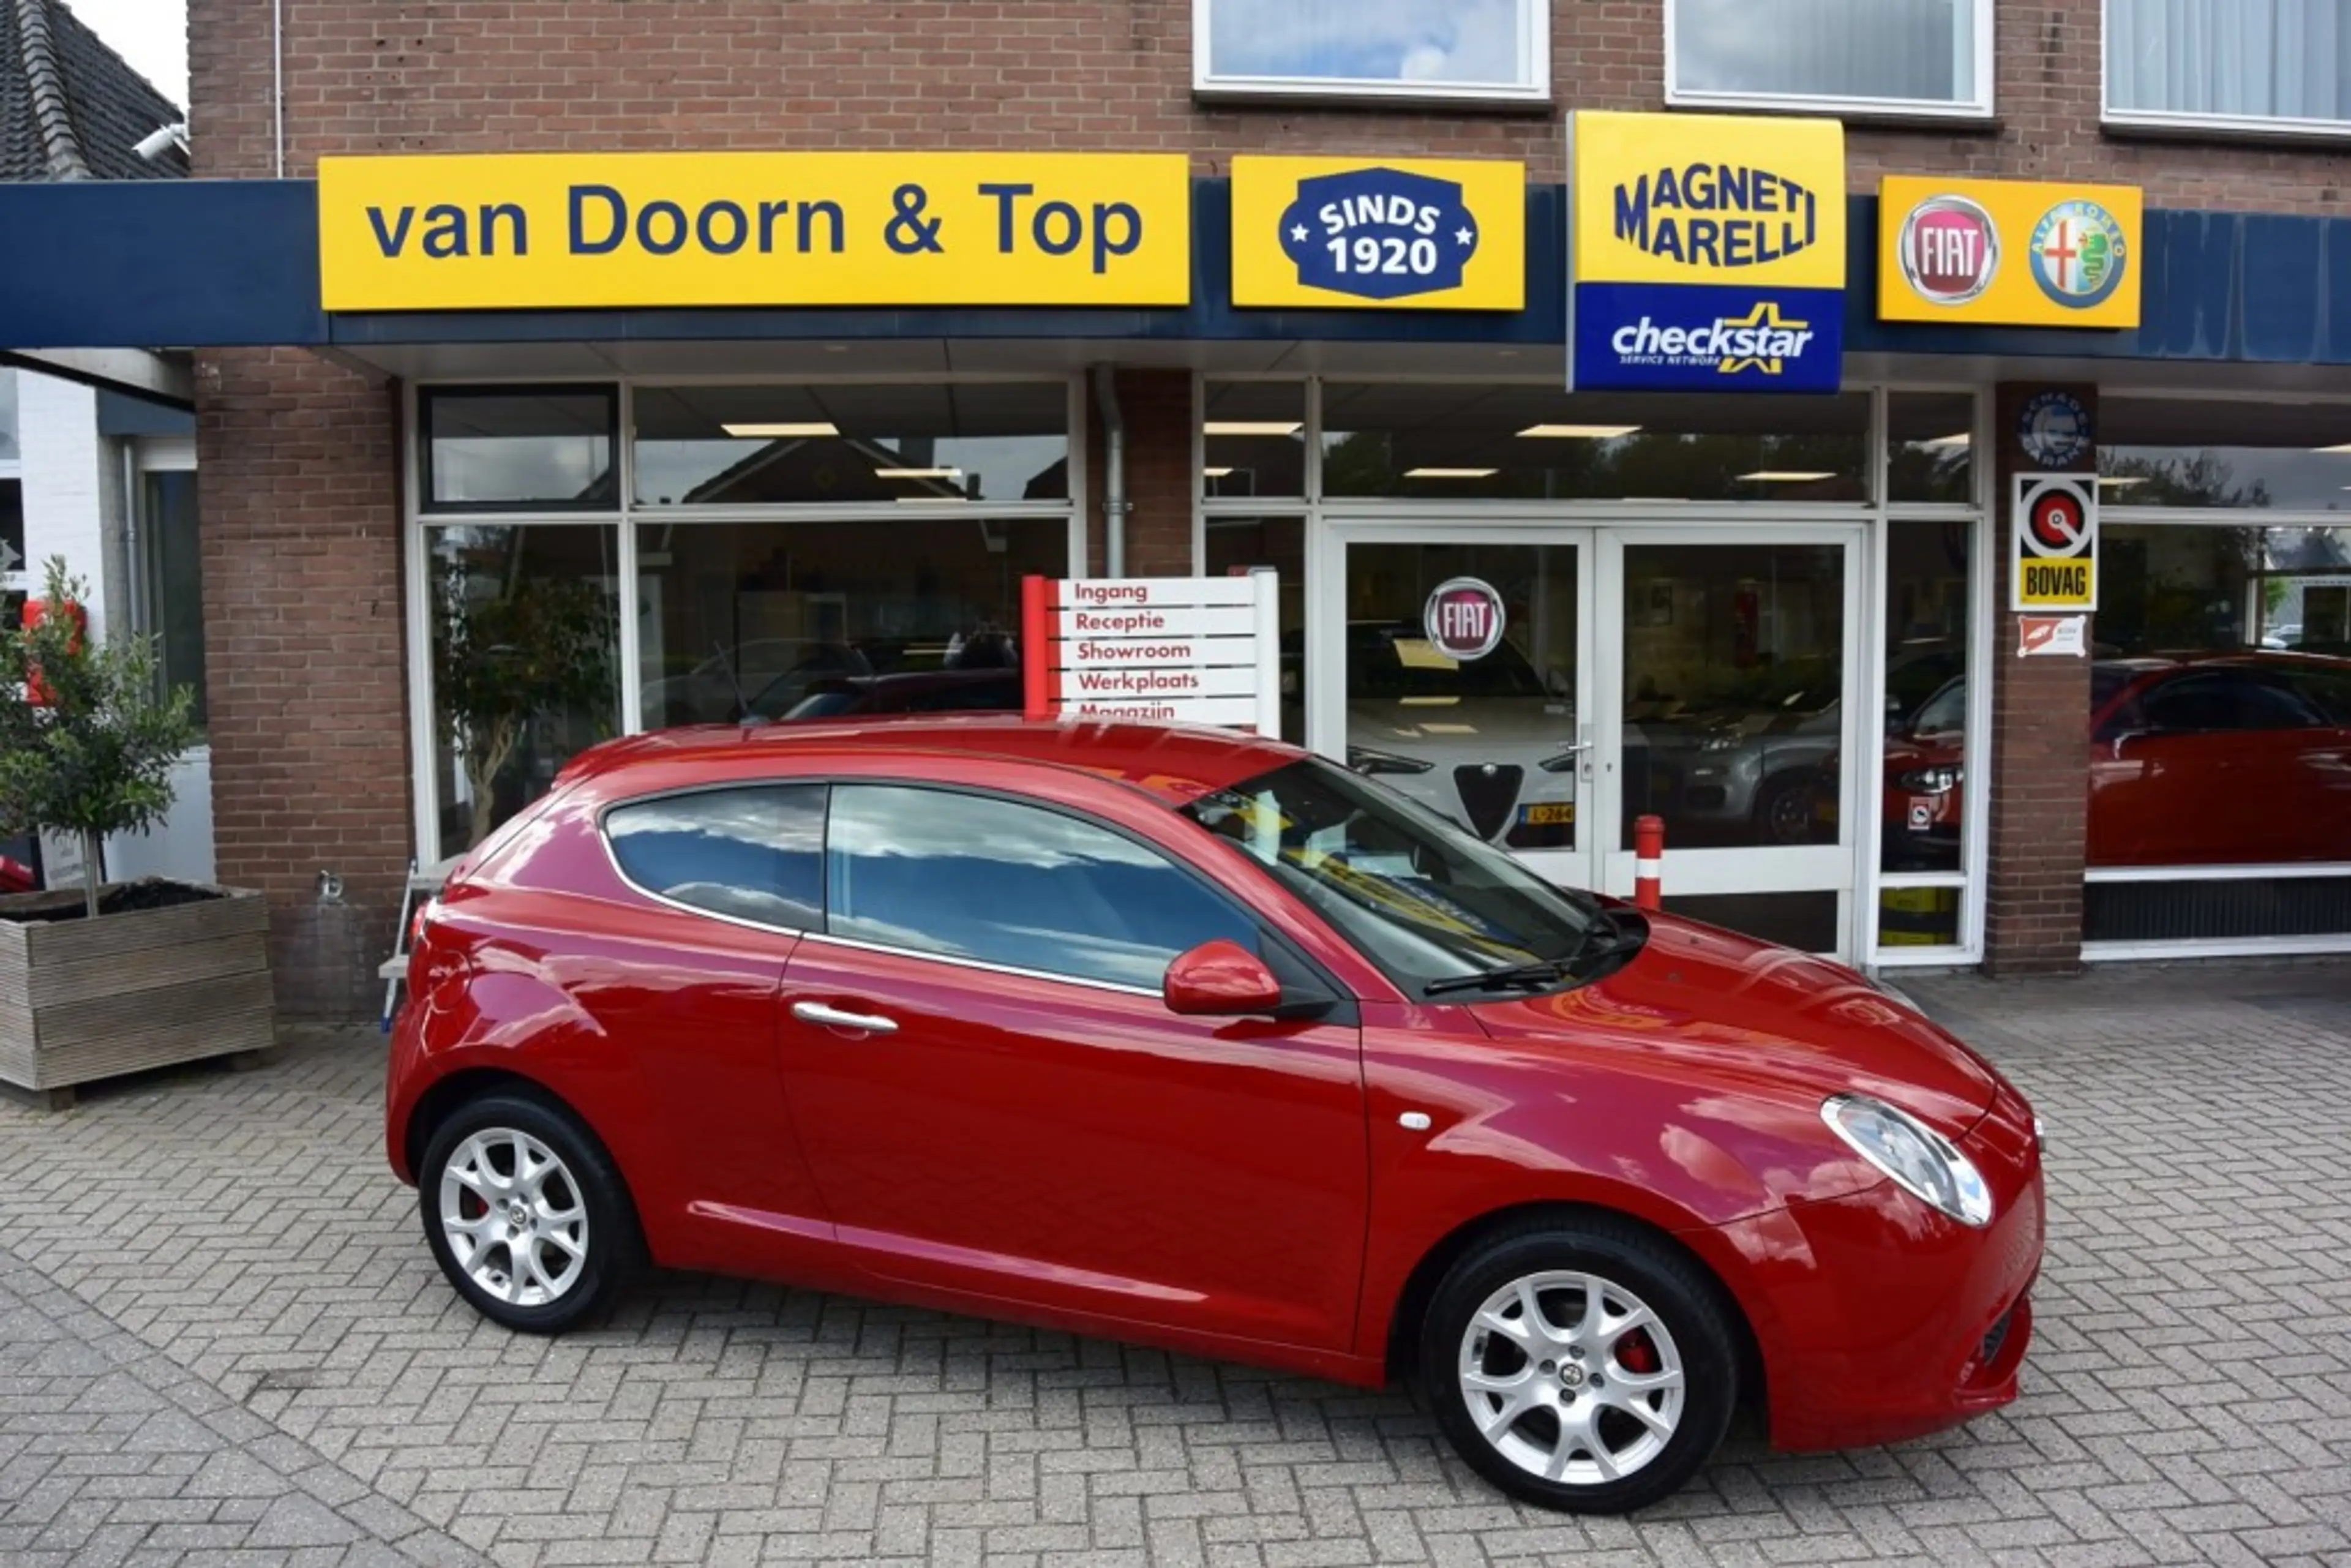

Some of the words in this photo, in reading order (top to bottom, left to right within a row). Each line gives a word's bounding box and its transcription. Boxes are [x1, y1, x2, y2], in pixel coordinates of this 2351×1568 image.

[1614, 162, 1815, 217] MAGNETI
[367, 201, 528, 257] van
[566, 184, 846, 255] Doorn
[883, 184, 946, 255] &
[977, 183, 1143, 274] Top
[1319, 194, 1441, 235] SINDS
[1326, 237, 1438, 274] 1920
[1614, 211, 1815, 267] MARELLI
[1921, 227, 1978, 277] FIAT
[1611, 316, 1815, 358] checkstar
[1075, 583, 1148, 604] Ingang
[2026, 566, 2086, 596] BOVAG
[1076, 610, 1164, 633] Receptie
[1443, 602, 1488, 638] FIAT
[1078, 641, 1191, 661] Showroom
[1079, 671, 1199, 693] Werkplaats
